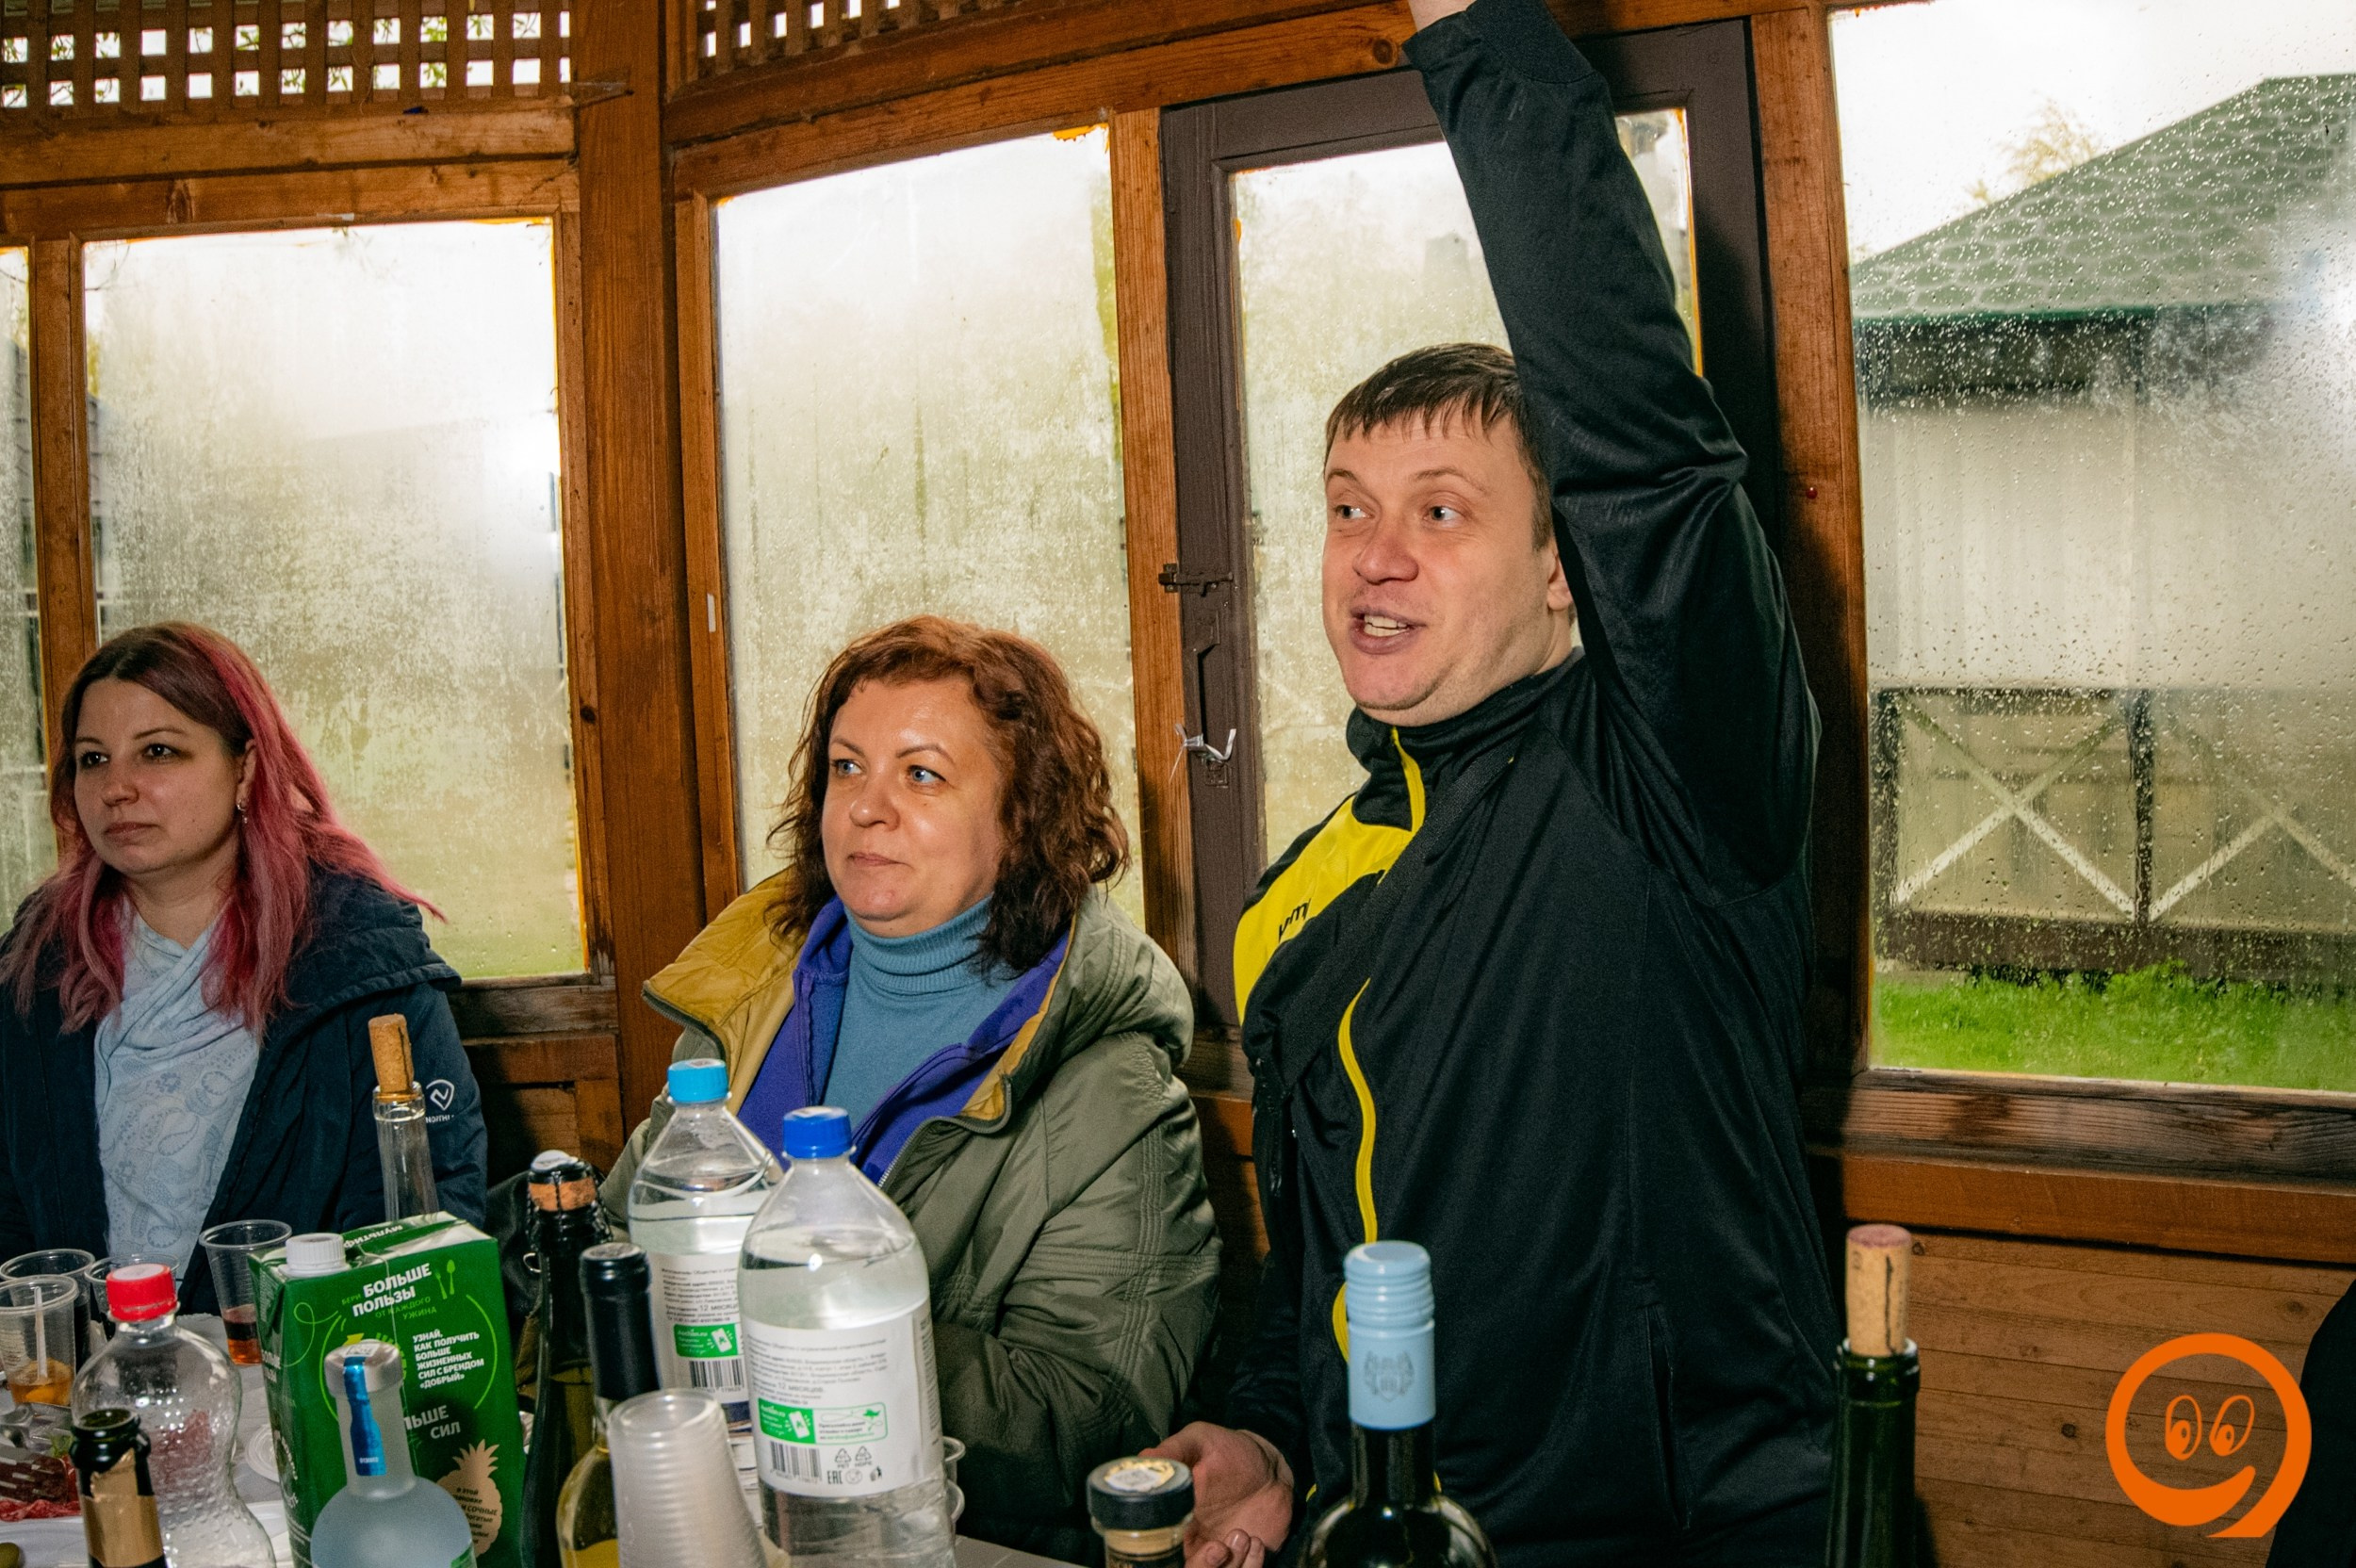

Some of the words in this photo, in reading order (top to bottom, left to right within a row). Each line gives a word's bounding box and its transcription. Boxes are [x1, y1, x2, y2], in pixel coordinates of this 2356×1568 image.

[341, 1294, 362, 1306] БЕРИ
[363, 1263, 433, 1298] БОЛЬШЕ
[352, 1286, 417, 1317] ПОЛЬЗЫ
[375, 1310, 385, 1319] ОТ
[387, 1296, 432, 1315] КАЖДОГО
[402, 1306, 437, 1320] УЖИНА
[414, 1341, 433, 1352] КАК
[434, 1331, 480, 1348] ПОЛУЧИТЬ
[415, 1347, 451, 1362] БОЛЬШЕ
[417, 1351, 473, 1370] ЖИЗНЕННЫХ
[417, 1367, 436, 1380] СИЛ
[436, 1367, 443, 1376] С
[443, 1358, 485, 1374] БРЕНДОМ
[419, 1372, 465, 1390] «ДОБРЫЙ»
[403, 1405, 450, 1430] ЛЬШЕ
[430, 1421, 461, 1439] СИЛ
